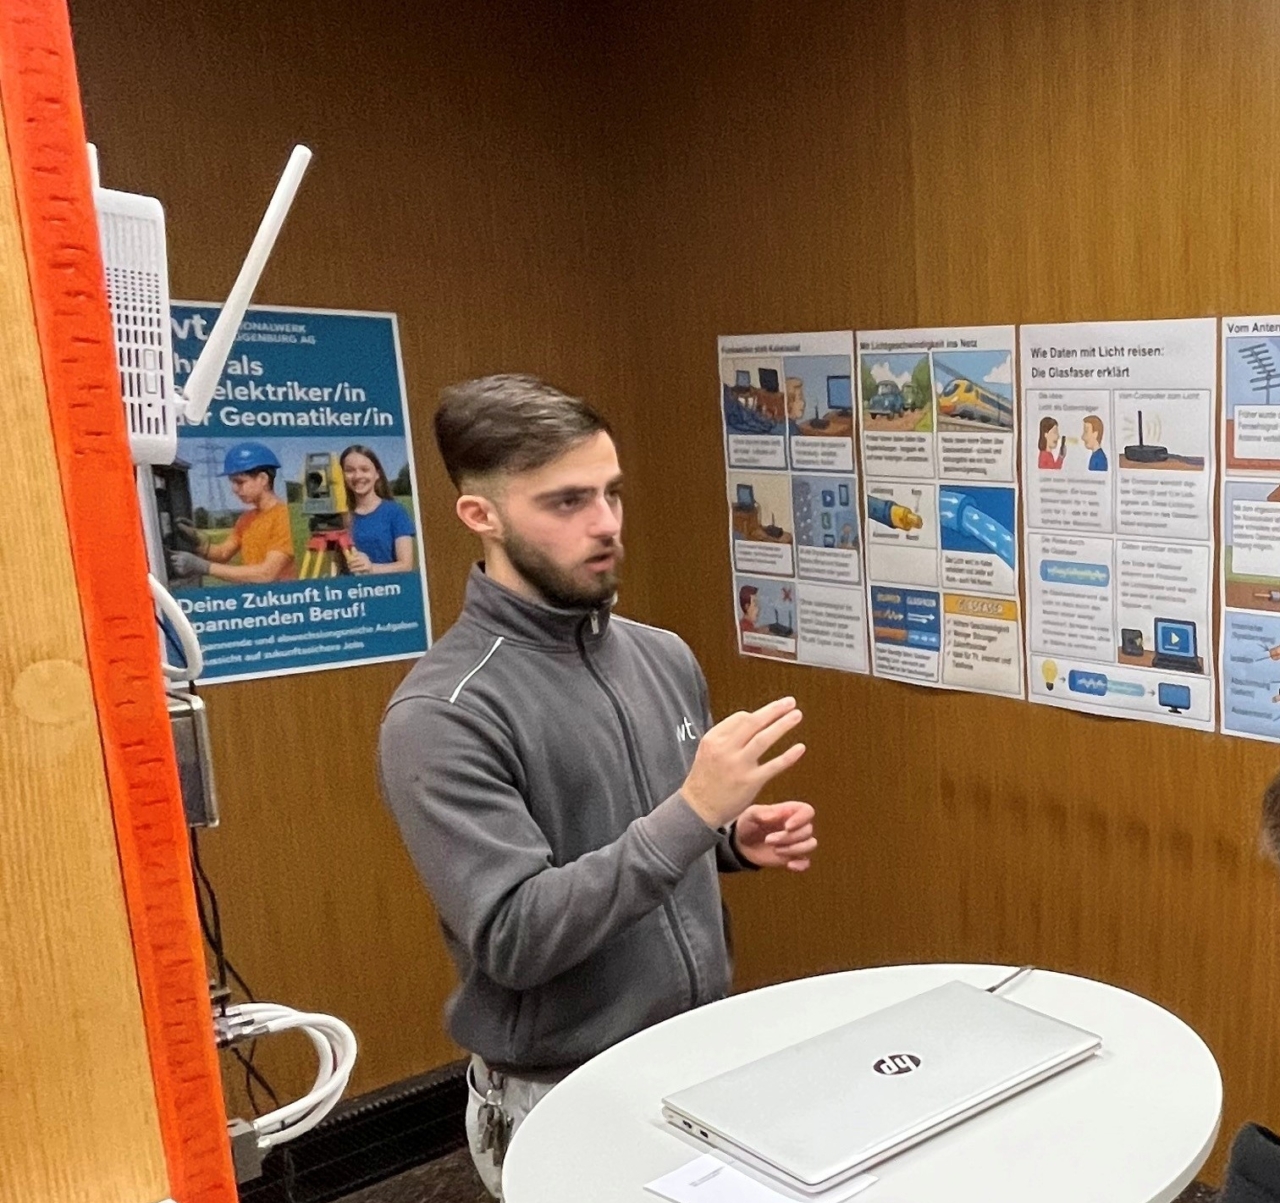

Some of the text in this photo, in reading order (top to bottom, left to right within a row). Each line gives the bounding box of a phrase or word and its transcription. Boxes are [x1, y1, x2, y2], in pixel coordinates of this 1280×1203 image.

[1227, 323, 1249, 334] Vom
[1030, 346, 1164, 359] Wie Daten mit Licht reisen:
[228, 354, 264, 376] als
[1031, 366, 1130, 378] Die Glasfaser erklärt
[220, 405, 394, 427] Geomatiker/in
[180, 582, 401, 615] Deine Zukunft in einem
[193, 602, 366, 634] pannenden Beruf!
